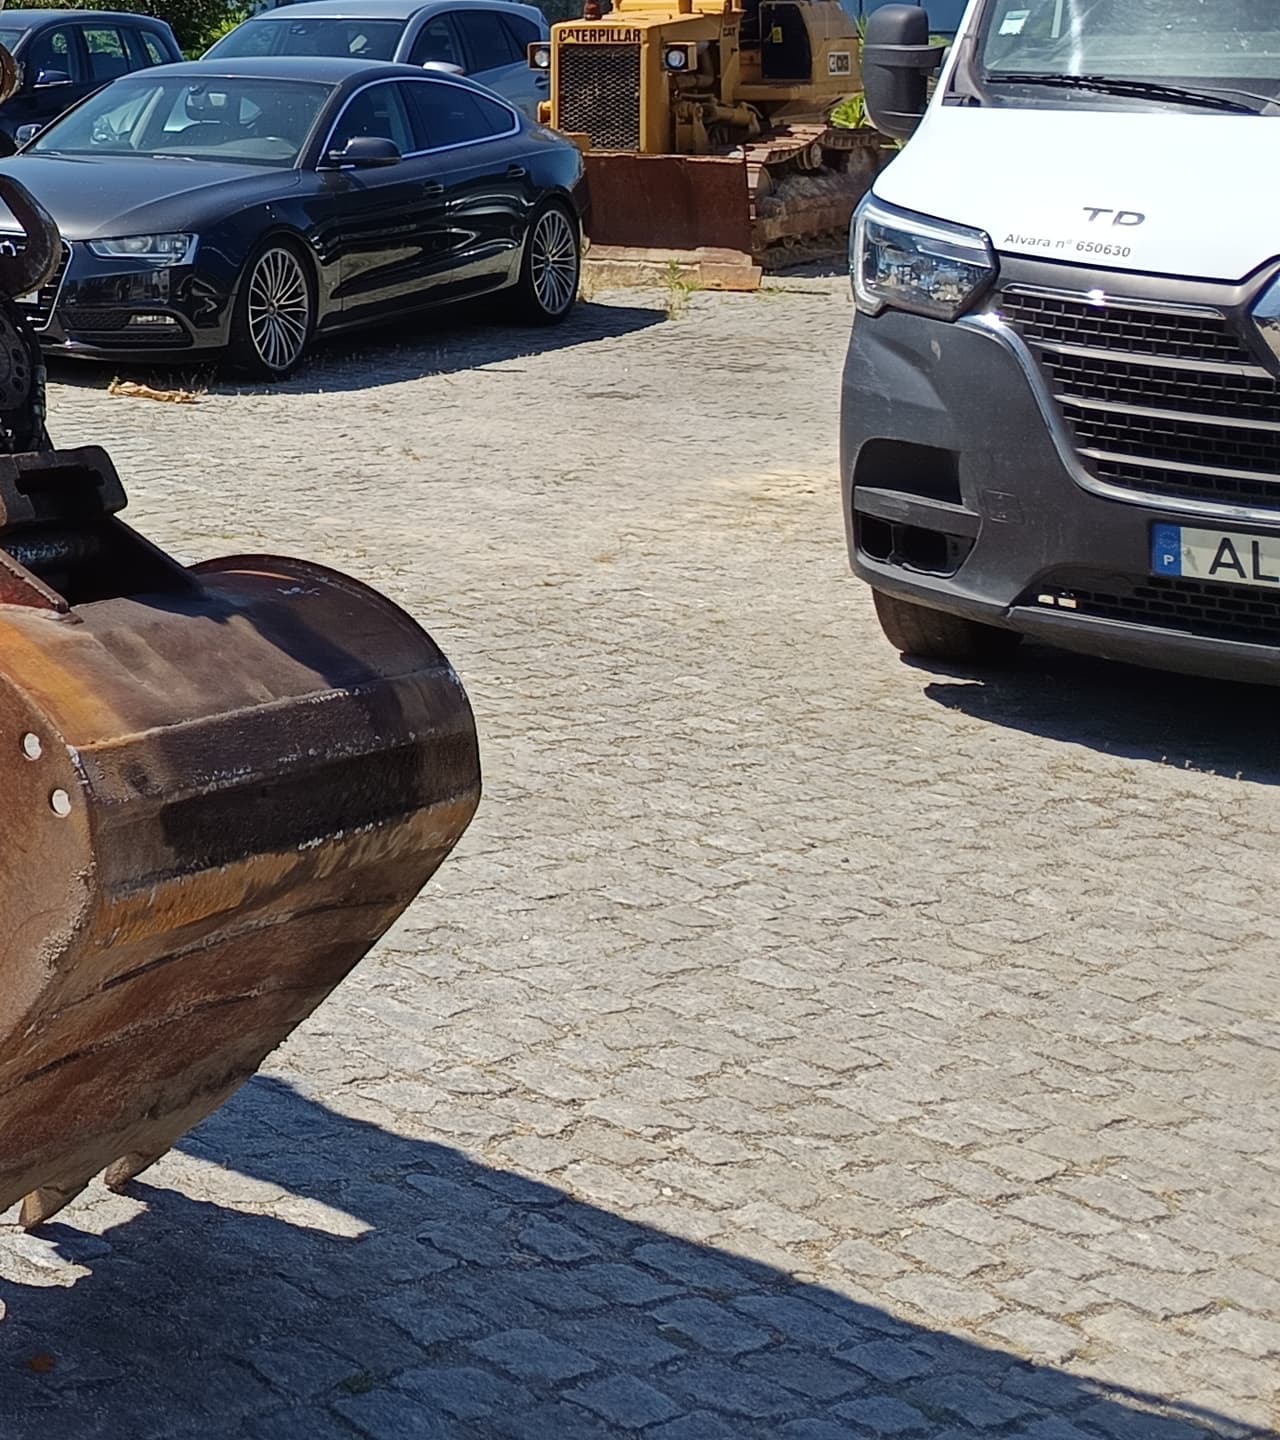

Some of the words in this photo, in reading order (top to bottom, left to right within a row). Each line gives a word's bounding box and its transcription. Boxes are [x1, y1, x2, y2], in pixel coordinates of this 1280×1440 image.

[558, 28, 641, 43] CATERPILLAR
[1082, 206, 1146, 227] TD
[1003, 233, 1051, 248] Alvara
[1075, 240, 1132, 258] 650630
[1163, 554, 1175, 566] P
[1208, 536, 1280, 583] AL
